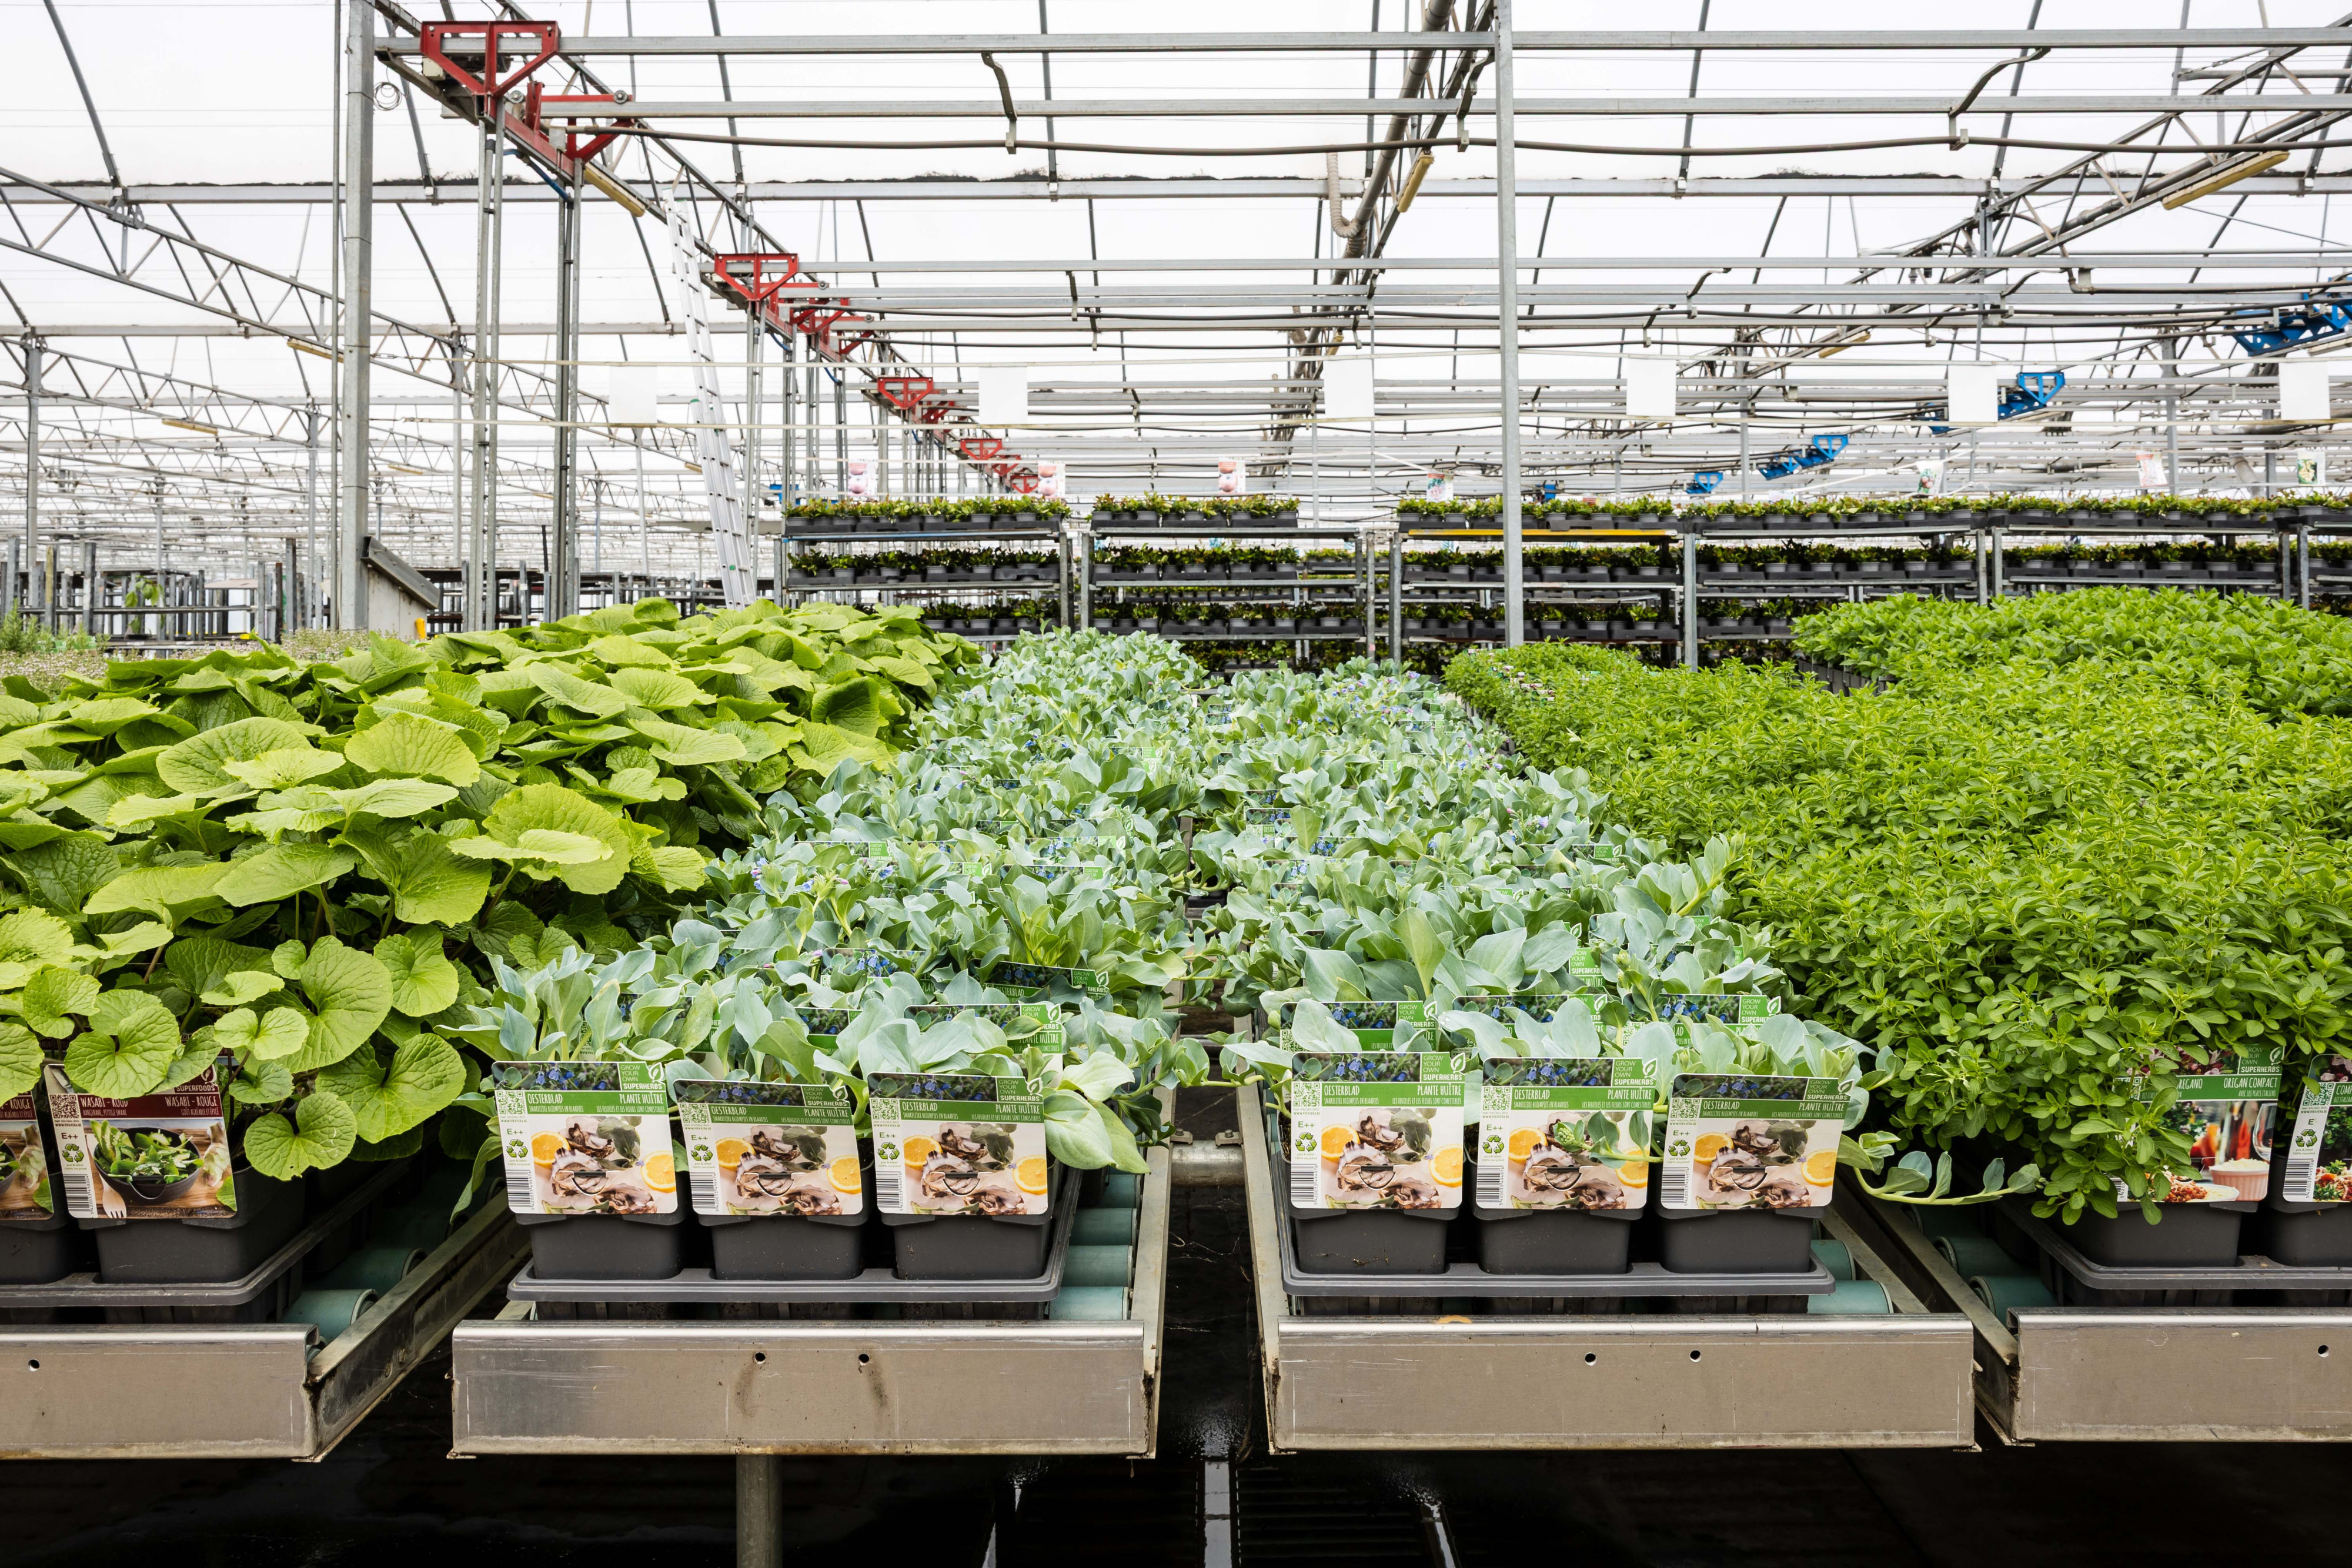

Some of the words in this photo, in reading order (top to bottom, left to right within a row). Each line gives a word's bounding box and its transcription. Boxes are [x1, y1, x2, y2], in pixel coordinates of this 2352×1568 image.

[1040, 1031, 1059, 1044] HUÎTRE
[2223, 1078, 2248, 1088] ORIGAN
[2249, 1077, 2278, 1088] COMPACT
[1324, 1085, 1359, 1095] OESTERBLAD
[1417, 1085, 1438, 1095] PLANTE
[1440, 1082, 1461, 1095] HUÎTRE
[1514, 1089, 1550, 1099] OESTERBLAD
[1607, 1089, 1629, 1099] PLANTE
[1630, 1087, 1652, 1099] HUÎTRE
[80, 1097, 106, 1108] WASABI
[165, 1096, 191, 1107] WASABI
[196, 1096, 218, 1106] ROUGE
[526, 1093, 563, 1104] OESTERBLAD
[619, 1094, 641, 1104] PLANTE
[641, 1091, 663, 1104] HUÎTRE
[9, 1099, 31, 1109] ROUGE
[901, 1101, 938, 1111] OESTERBLAD
[995, 1104, 1017, 1114] PLANTE
[1018, 1102, 1040, 1114] HUÎTRE
[1702, 1101, 1740, 1110] OESTERBLAD
[1798, 1102, 1822, 1111] PLANTE
[1822, 1101, 1845, 1112] HUÎTRE
[710, 1106, 747, 1115] OESTERBLAD
[803, 1108, 826, 1116] PLANTE
[826, 1106, 848, 1117] HUÎTRE
